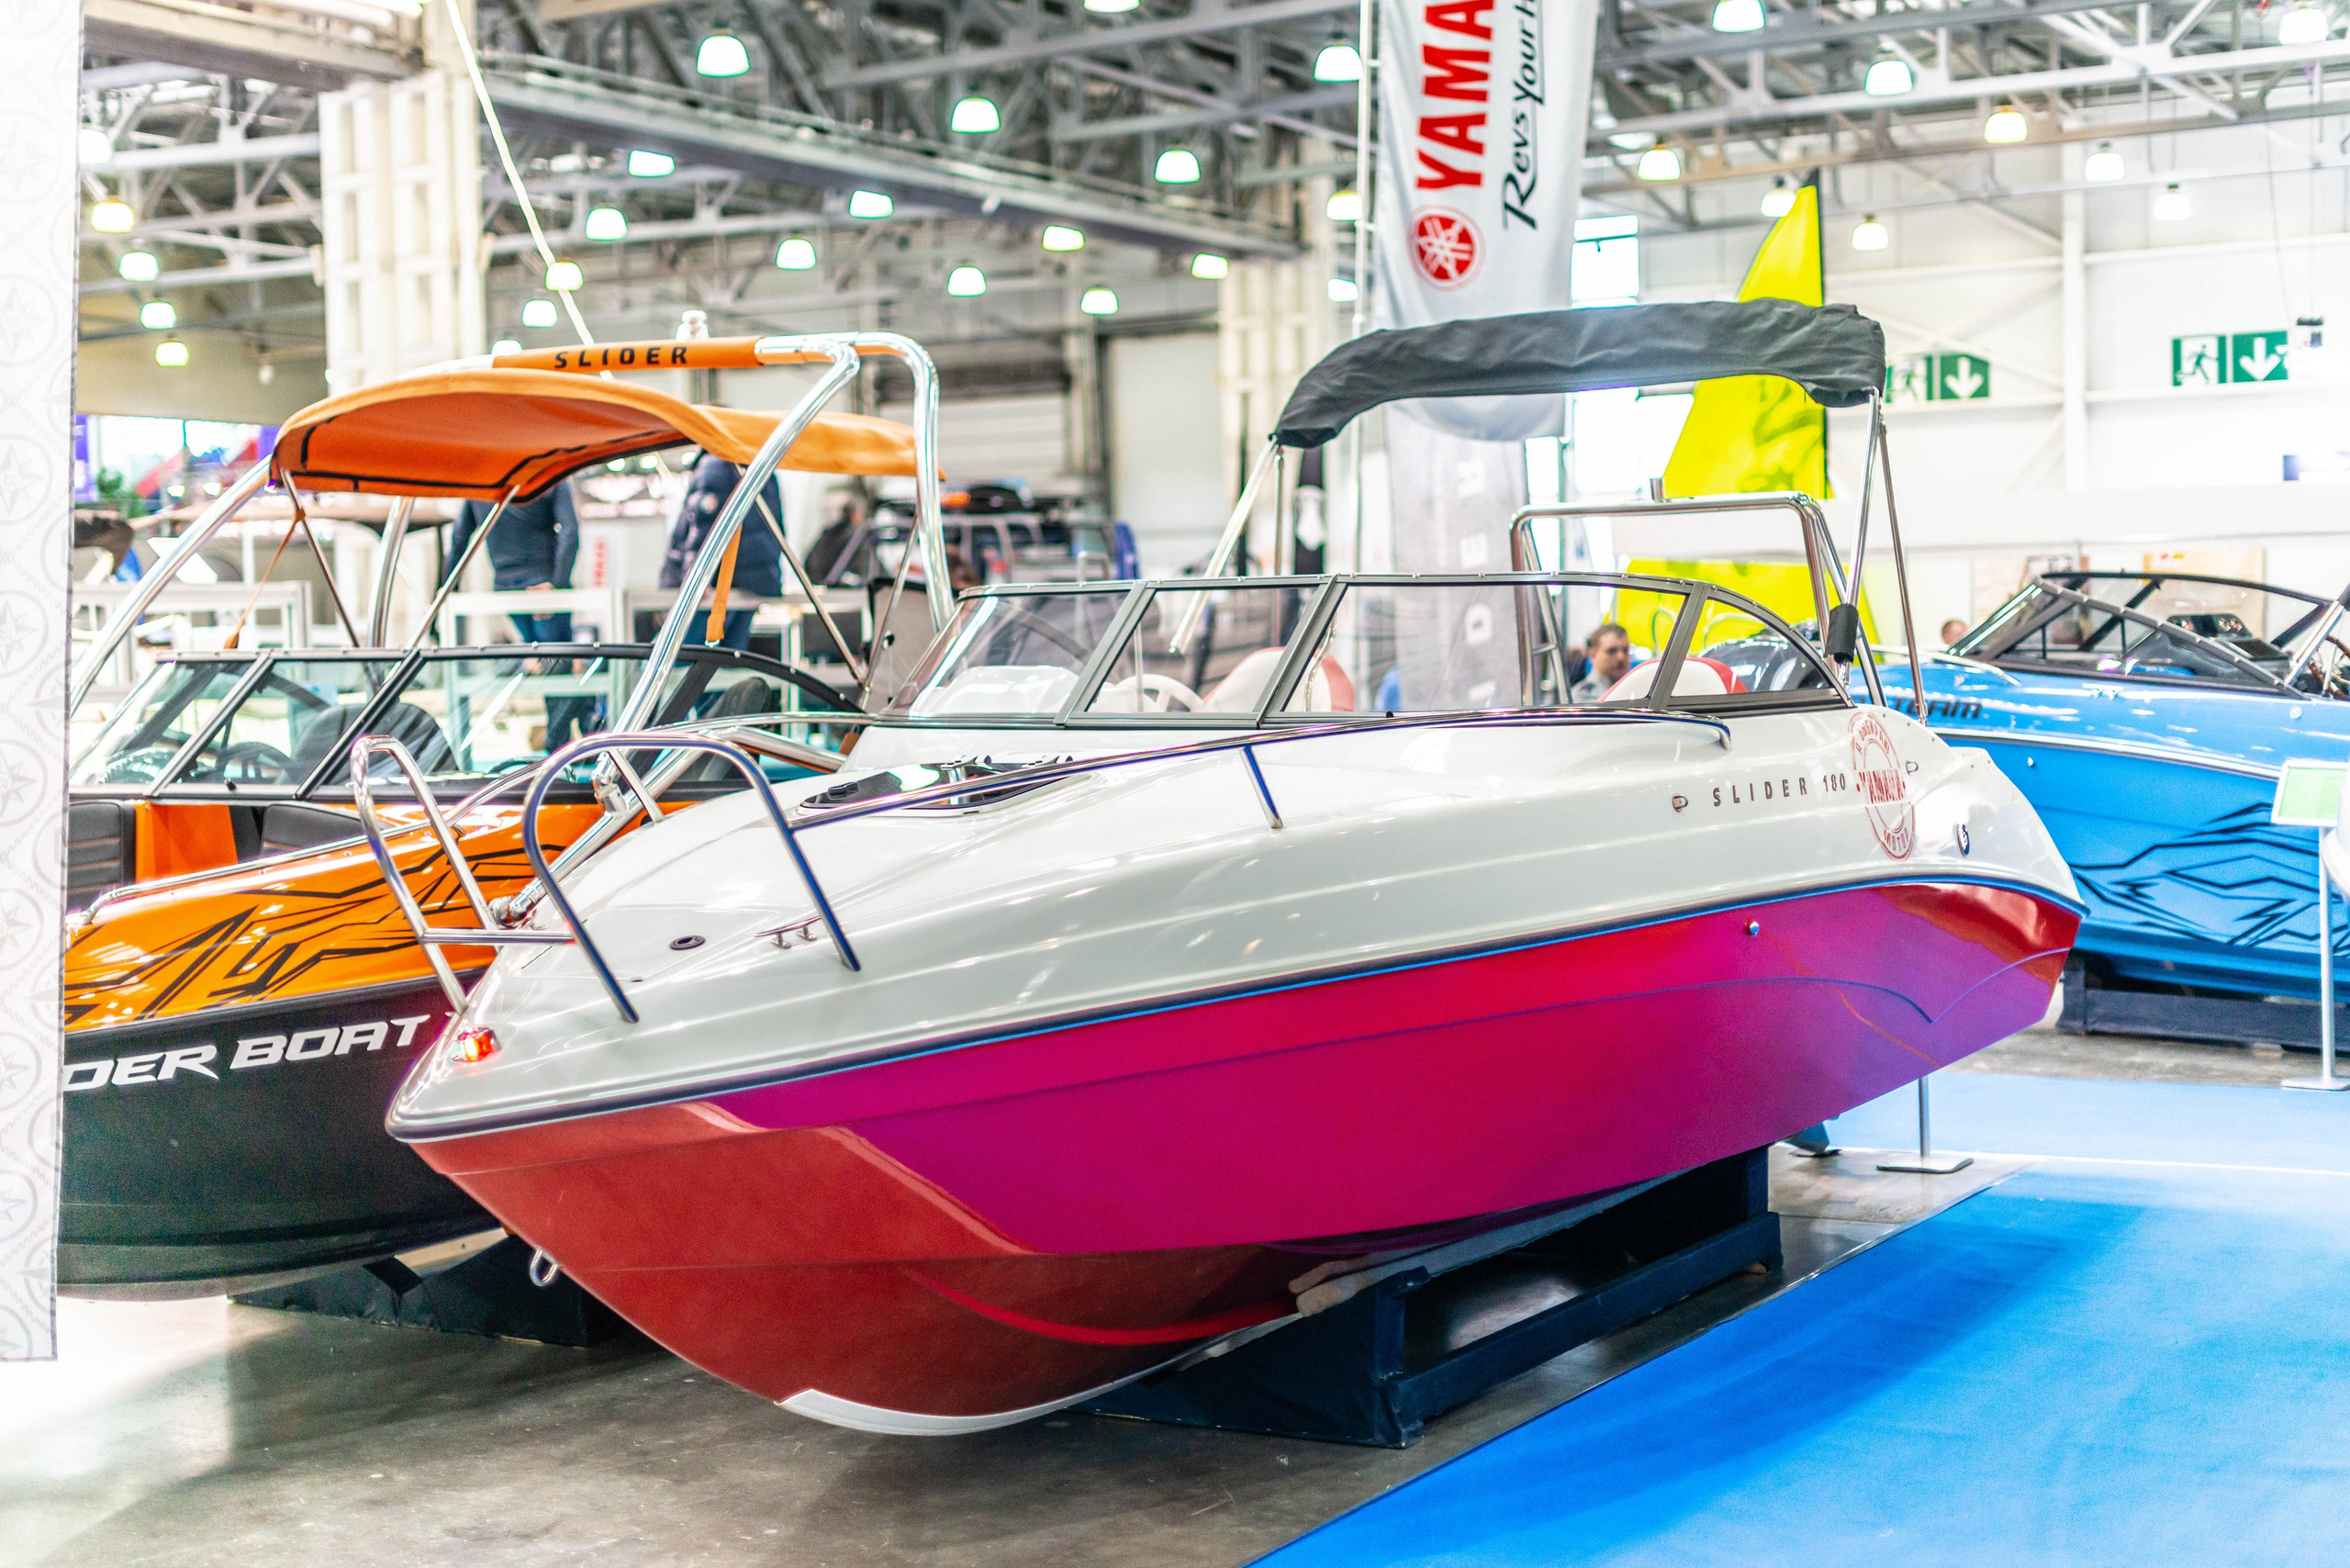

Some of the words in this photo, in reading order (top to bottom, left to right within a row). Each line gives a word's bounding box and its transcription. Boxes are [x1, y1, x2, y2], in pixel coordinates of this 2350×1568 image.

[1513, 18, 1544, 106] Your
[1416, 0, 1495, 190] YAMA
[1502, 107, 1538, 230] Revs
[554, 346, 688, 369] SLIDER
[1713, 778, 1807, 807] SLIDER
[1823, 773, 1846, 792] 180
[1859, 768, 1905, 804] YAMAHA
[230, 1014, 431, 1070] BOAT
